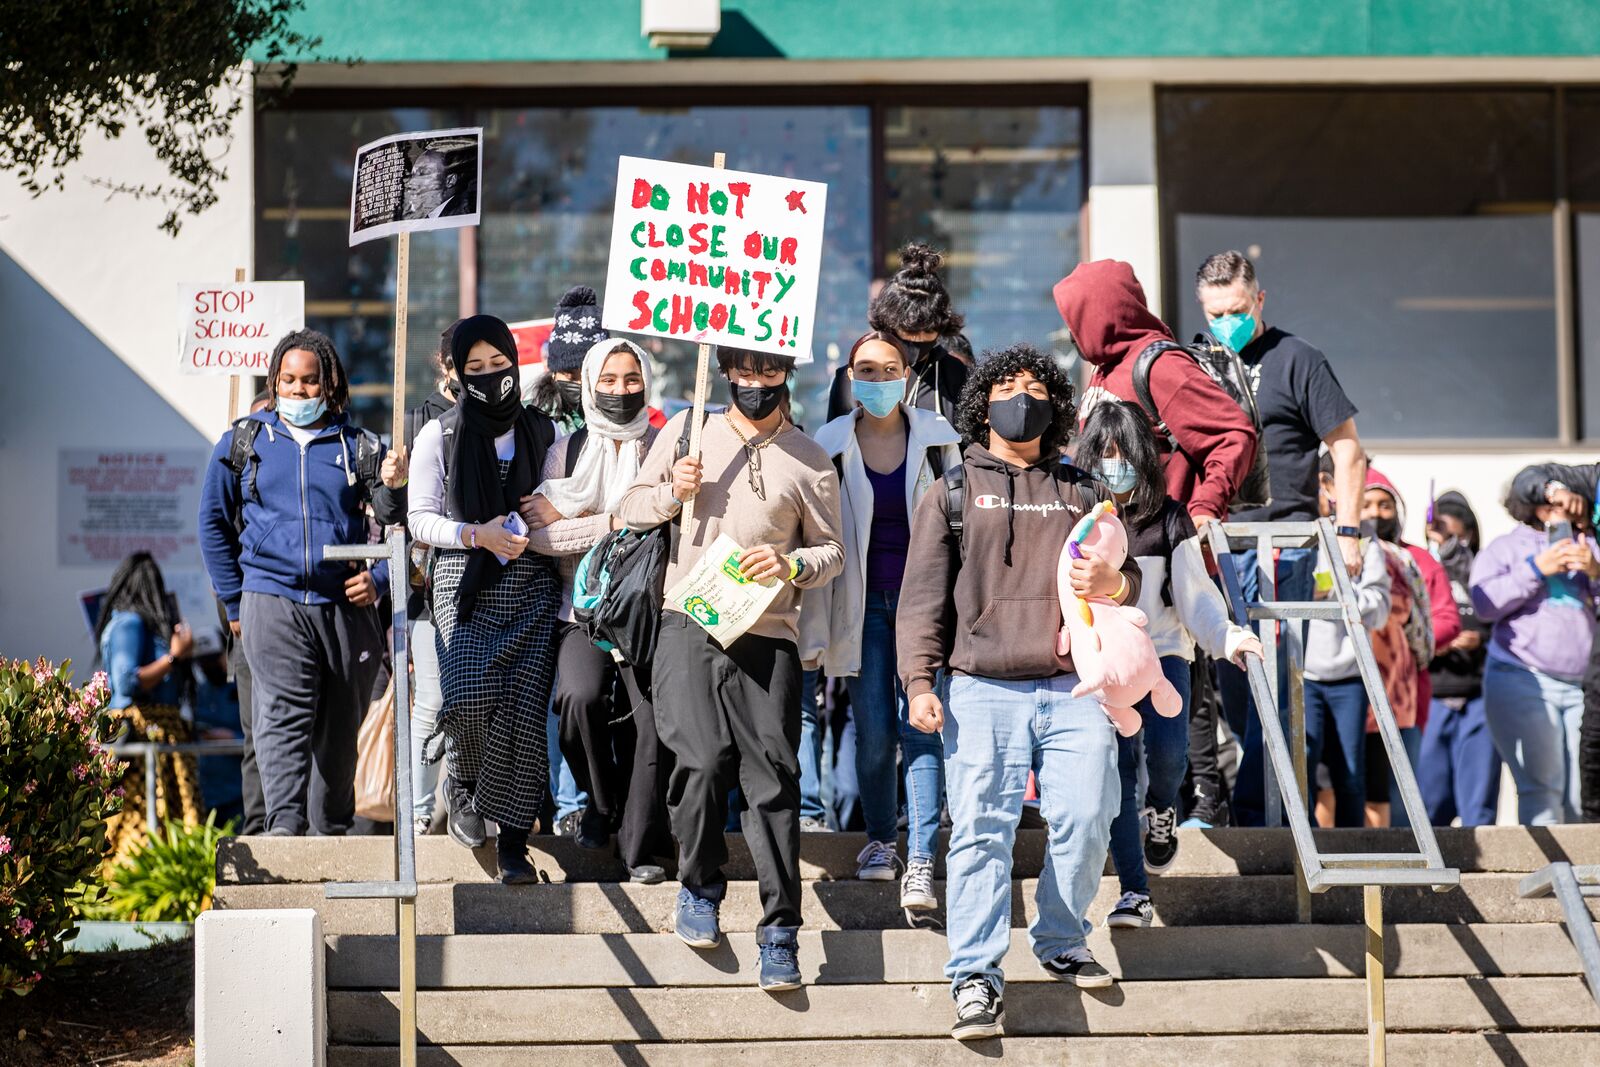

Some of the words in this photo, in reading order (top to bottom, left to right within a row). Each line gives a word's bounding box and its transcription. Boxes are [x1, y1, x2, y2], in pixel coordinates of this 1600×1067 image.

[631, 178, 671, 211] DO
[687, 181, 751, 219] NOT
[630, 221, 728, 258] CLOSE
[744, 231, 798, 265] OUR
[195, 290, 254, 314] STOP
[194, 319, 270, 339] SCHOOL
[974, 494, 1082, 518] Champin
